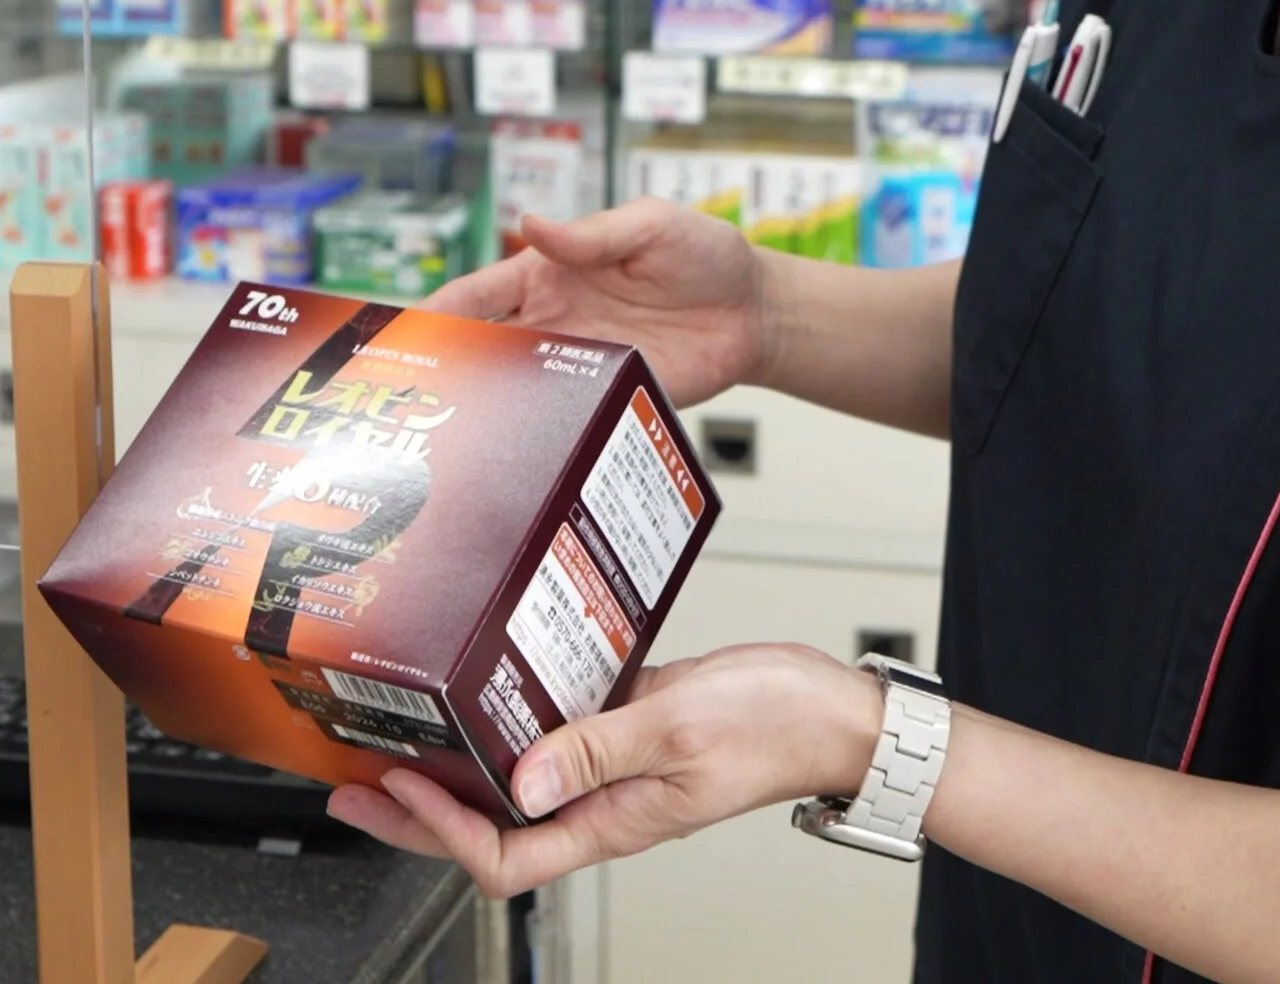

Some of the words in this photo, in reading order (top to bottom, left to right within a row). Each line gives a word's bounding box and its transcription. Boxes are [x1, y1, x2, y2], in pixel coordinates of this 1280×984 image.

[229, 318, 287, 336] WAKUNAGA
[238, 290, 299, 323] 70th
[282, 370, 457, 430] レオピン
[259, 403, 432, 461] ロイヤル
